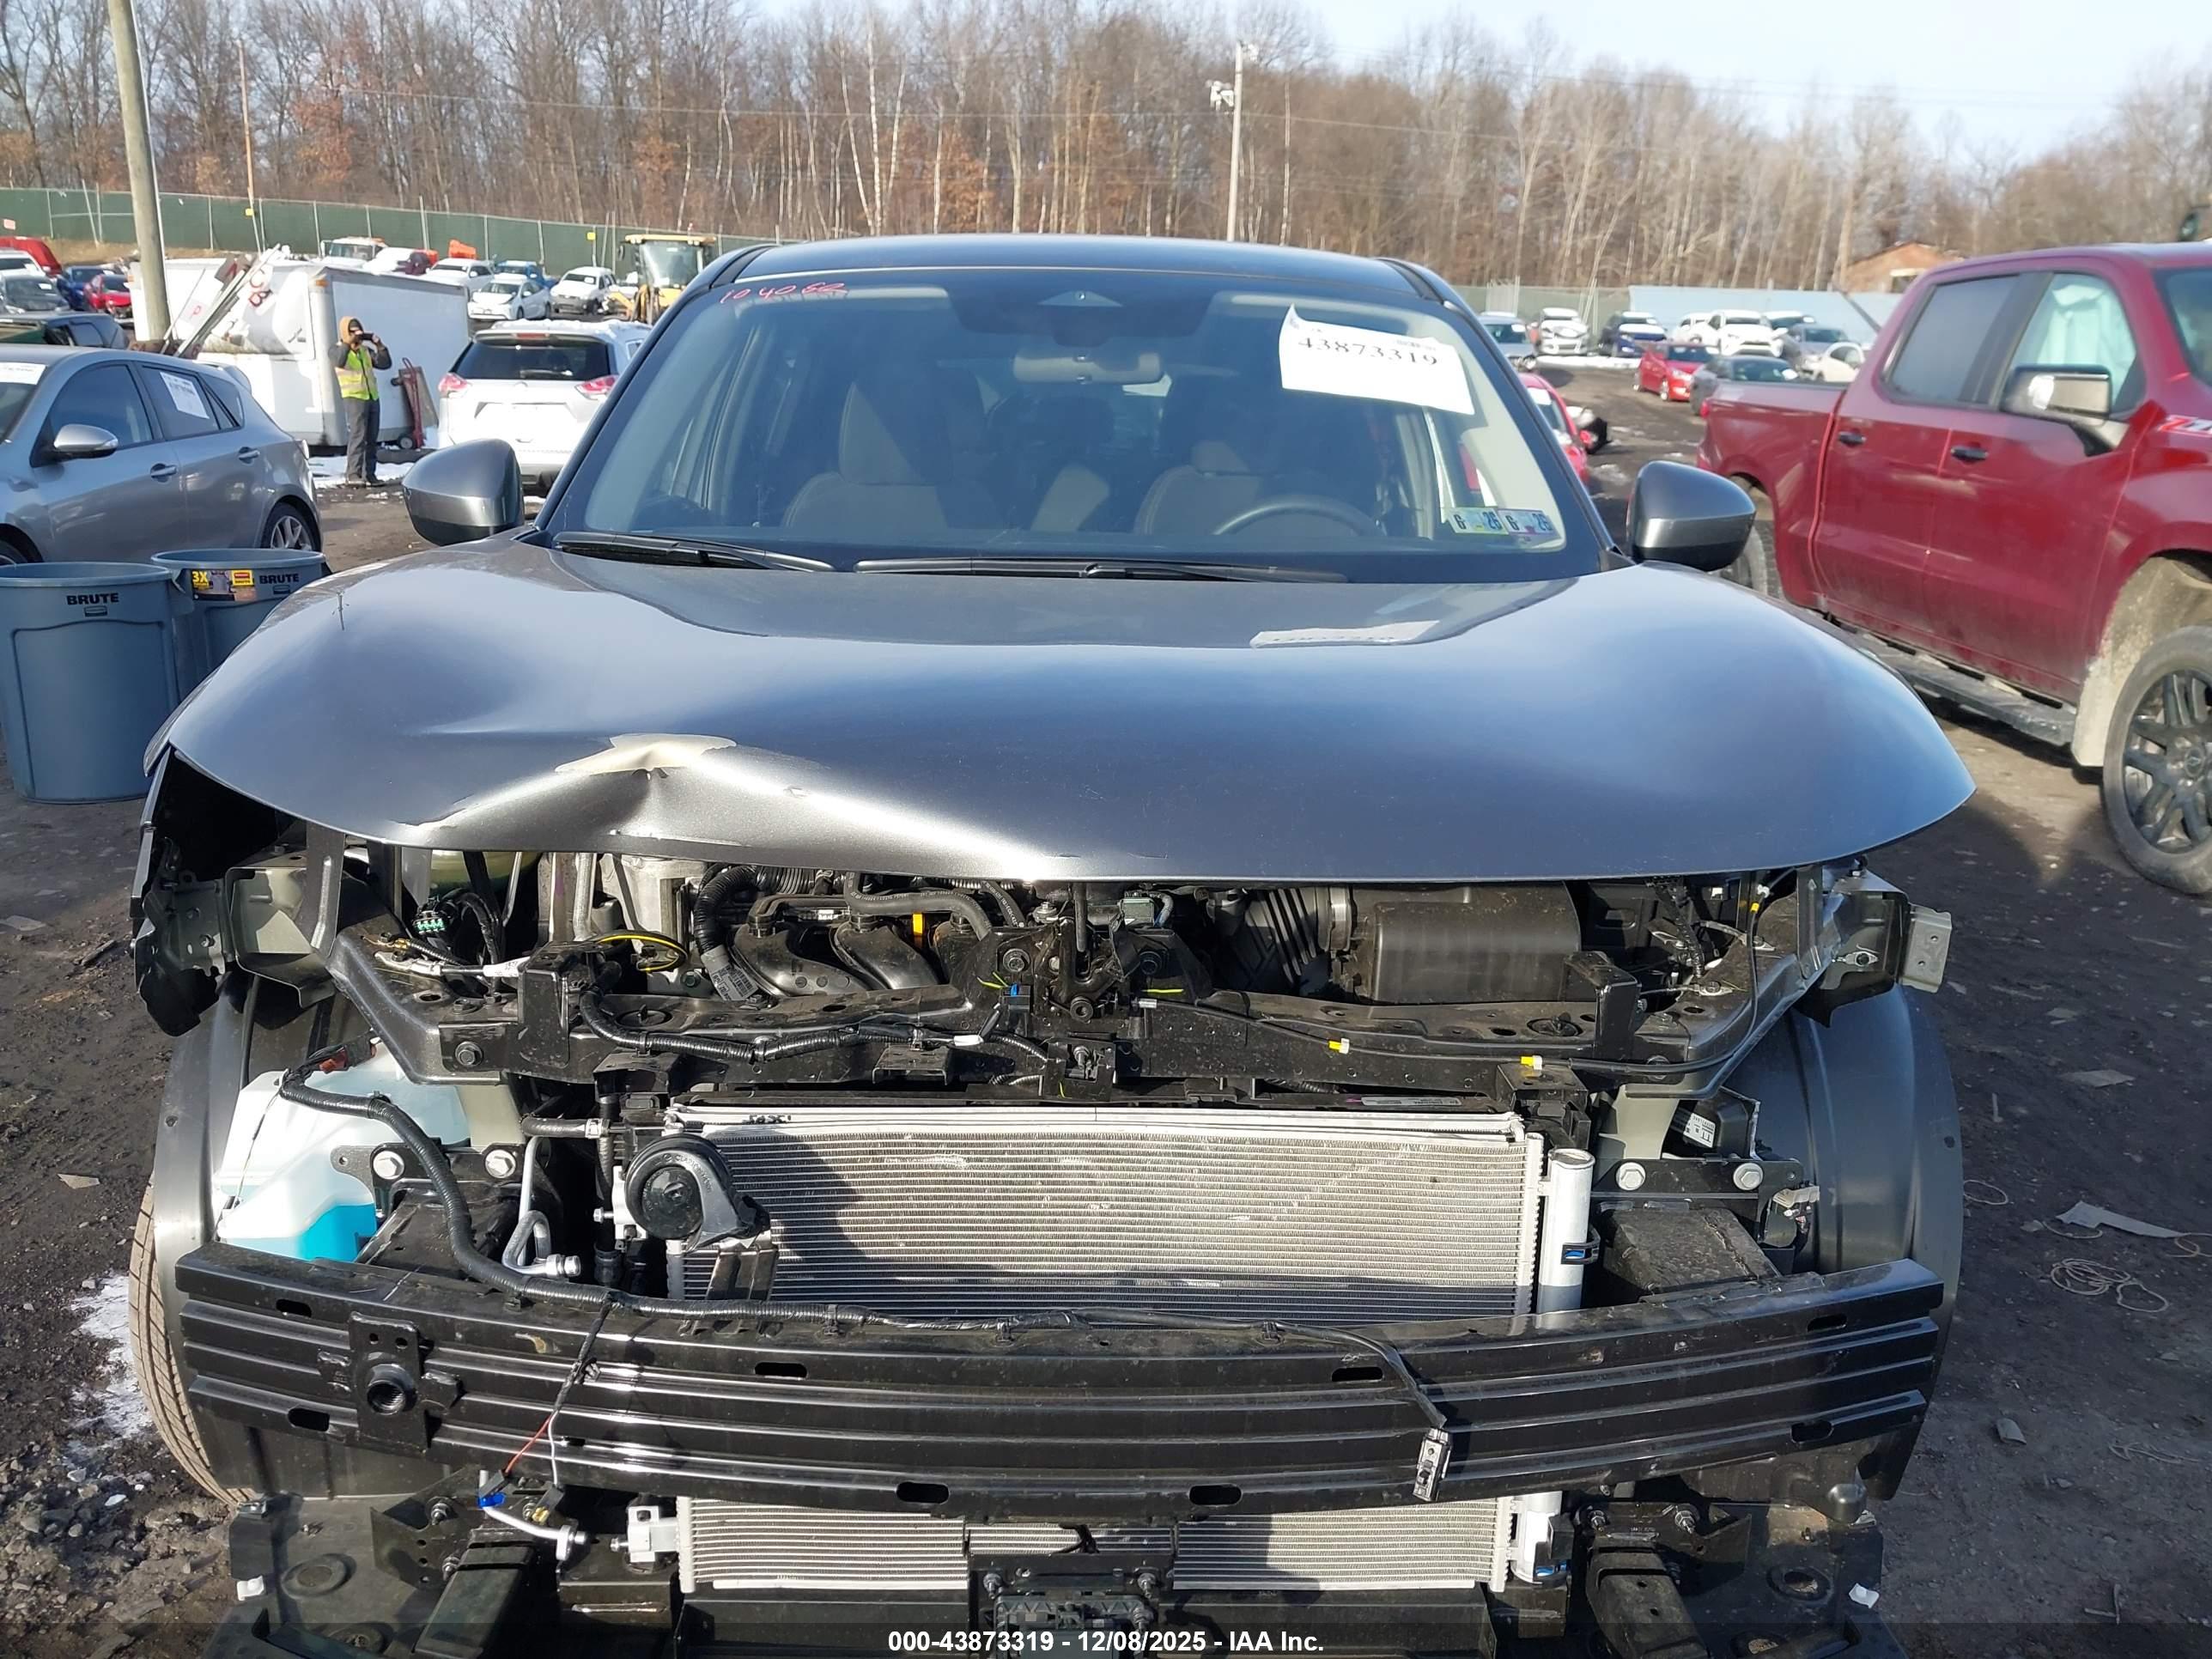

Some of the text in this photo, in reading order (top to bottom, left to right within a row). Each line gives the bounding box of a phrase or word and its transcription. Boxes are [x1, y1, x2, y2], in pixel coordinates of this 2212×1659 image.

[1297, 337, 1437, 365] 43873319
[191, 570, 209, 583] 3X
[258, 573, 300, 585] BRUTE
[66, 592, 119, 605] BRUTE
